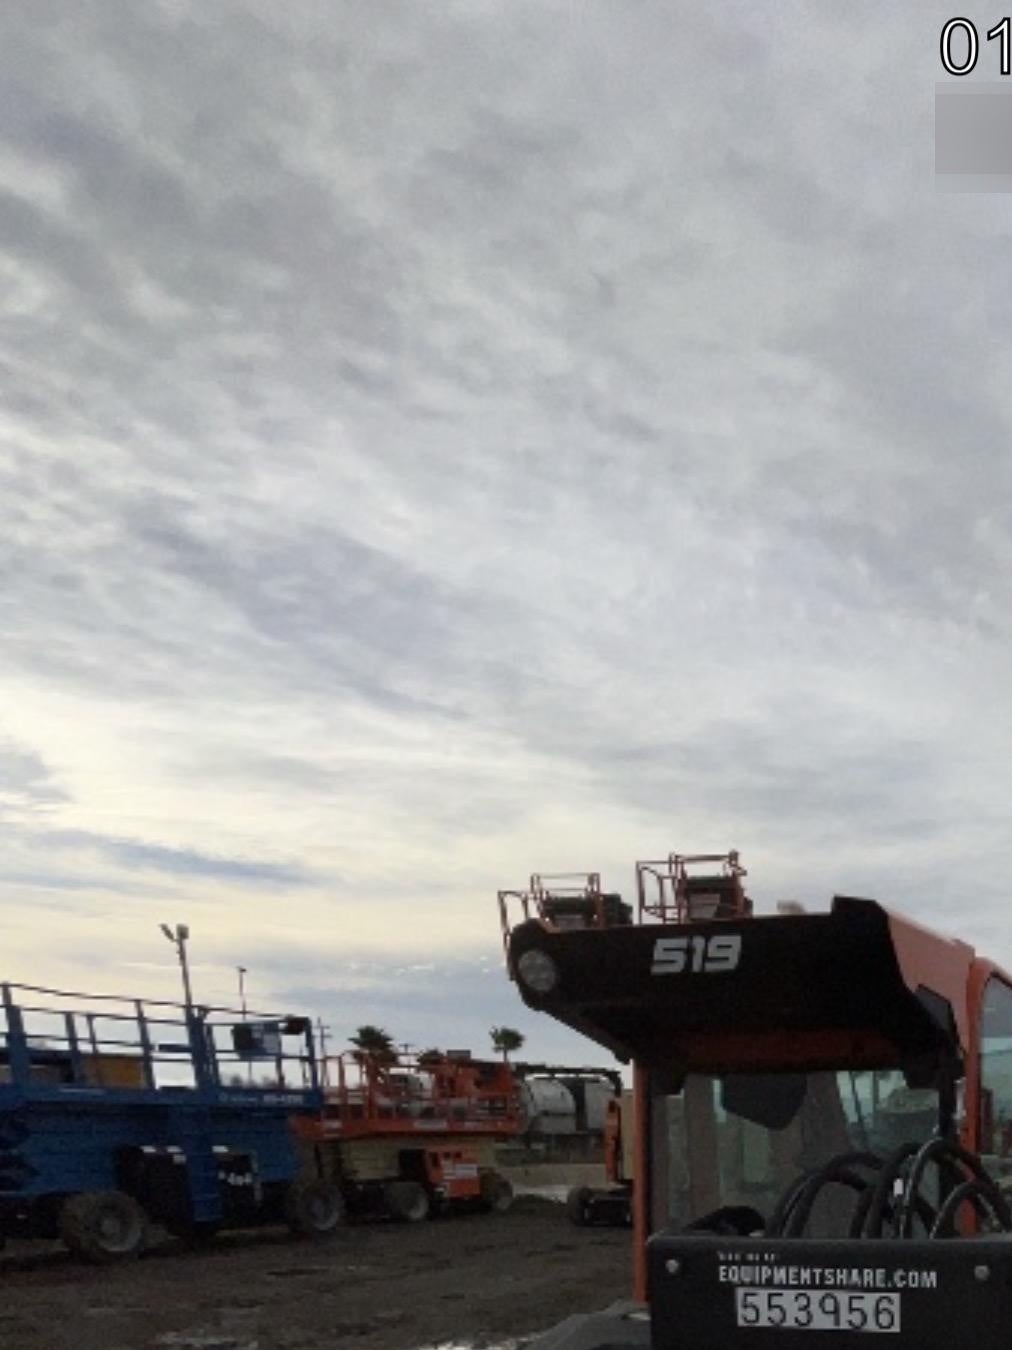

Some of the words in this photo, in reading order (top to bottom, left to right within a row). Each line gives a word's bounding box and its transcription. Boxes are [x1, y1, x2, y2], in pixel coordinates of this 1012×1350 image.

[650, 935, 742, 975] 519
[718, 1265, 938, 1288] EQUIPMENTSHARE.COM
[740, 1292, 896, 1330] 553956
